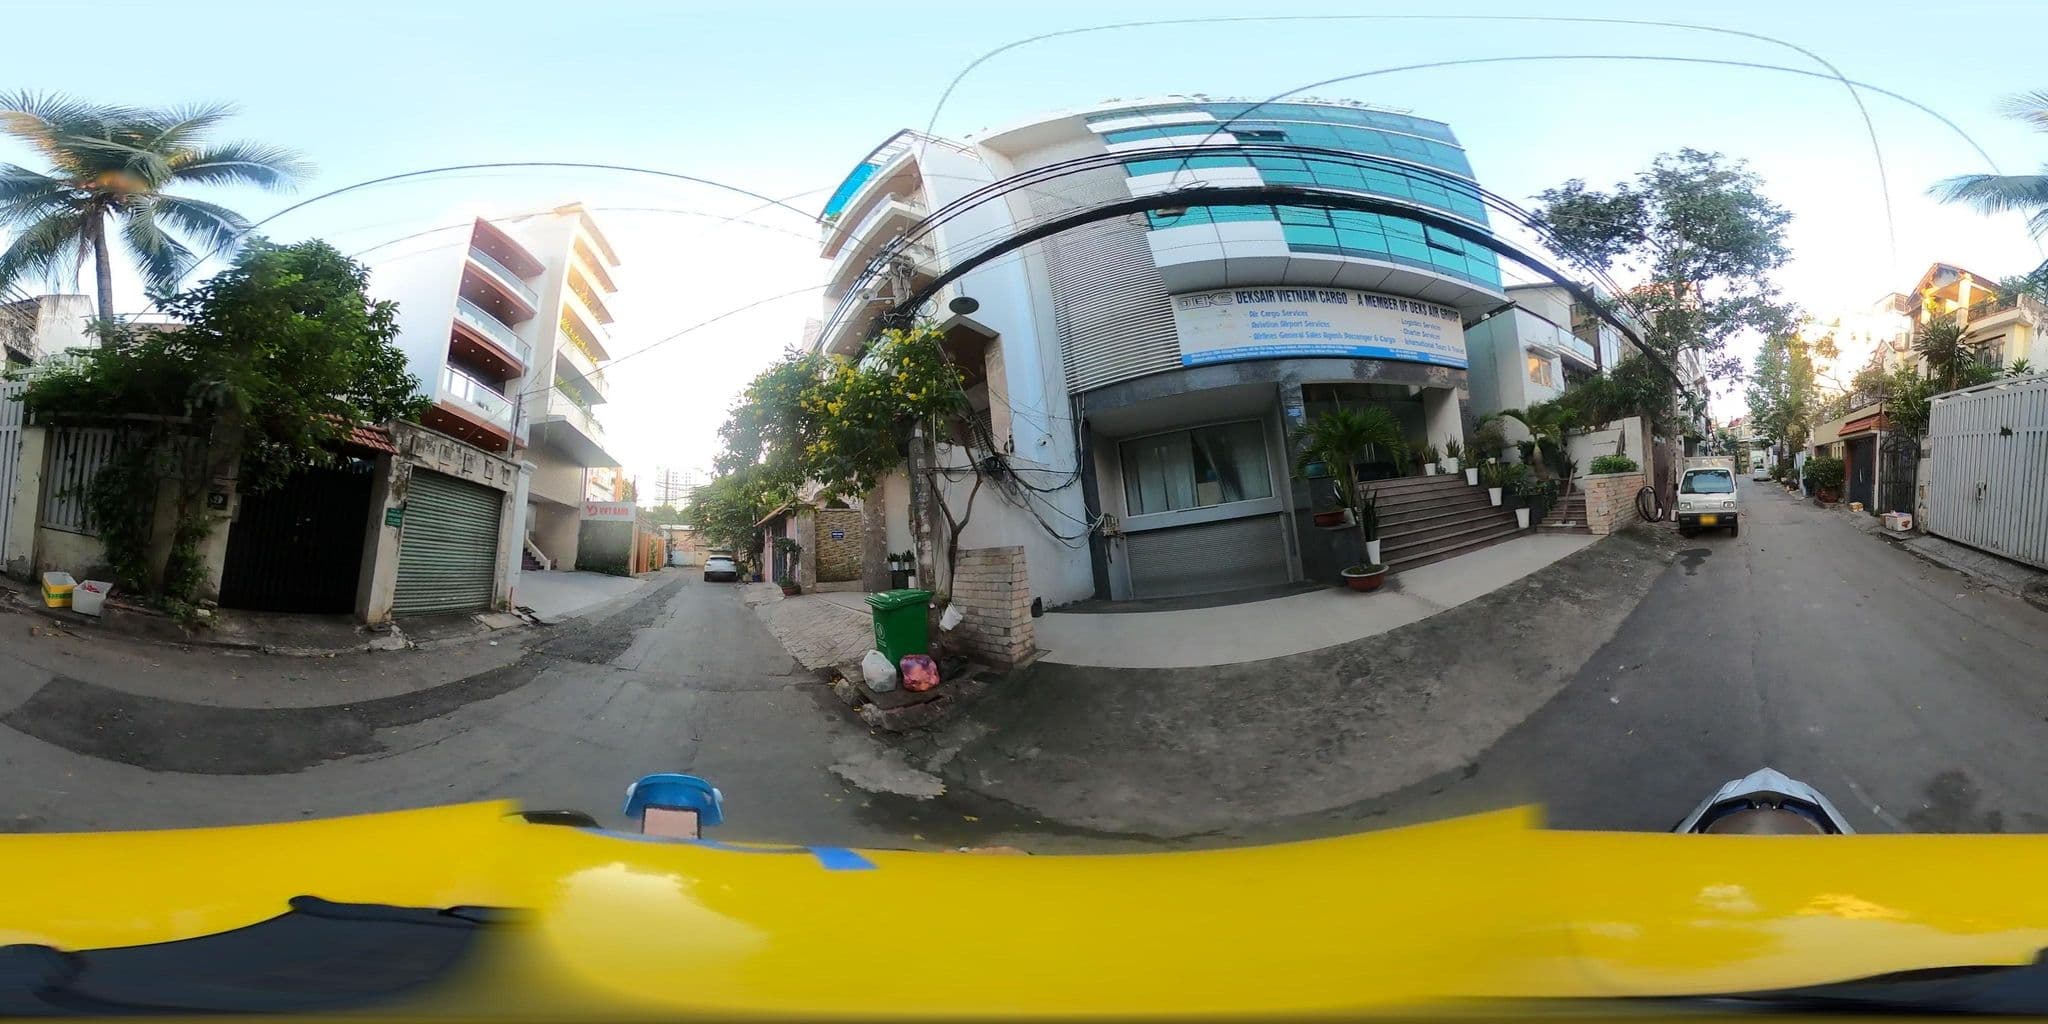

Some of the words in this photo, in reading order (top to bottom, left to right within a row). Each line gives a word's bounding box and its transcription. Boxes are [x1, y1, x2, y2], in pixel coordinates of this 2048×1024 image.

[1179, 292, 1232, 311] DEKS
[1236, 290, 1275, 304] DEKSAIR
[1279, 290, 1316, 303] VIETNAM
[1320, 290, 1348, 304] CARGO
[1357, 294, 1363, 306] A
[1365, 294, 1398, 311] MEMBER
[1400, 300, 1408, 311] OF
[1410, 301, 1427, 315] DEKS
[1429, 305, 1439, 318] AIR
[1260, 310, 1280, 318] Cargo
[1282, 309, 1308, 317] Services
[1280, 321, 1302, 329] Airport
[1253, 332, 1277, 340] Airlines
[1380, 335, 1396, 343] Cargo
